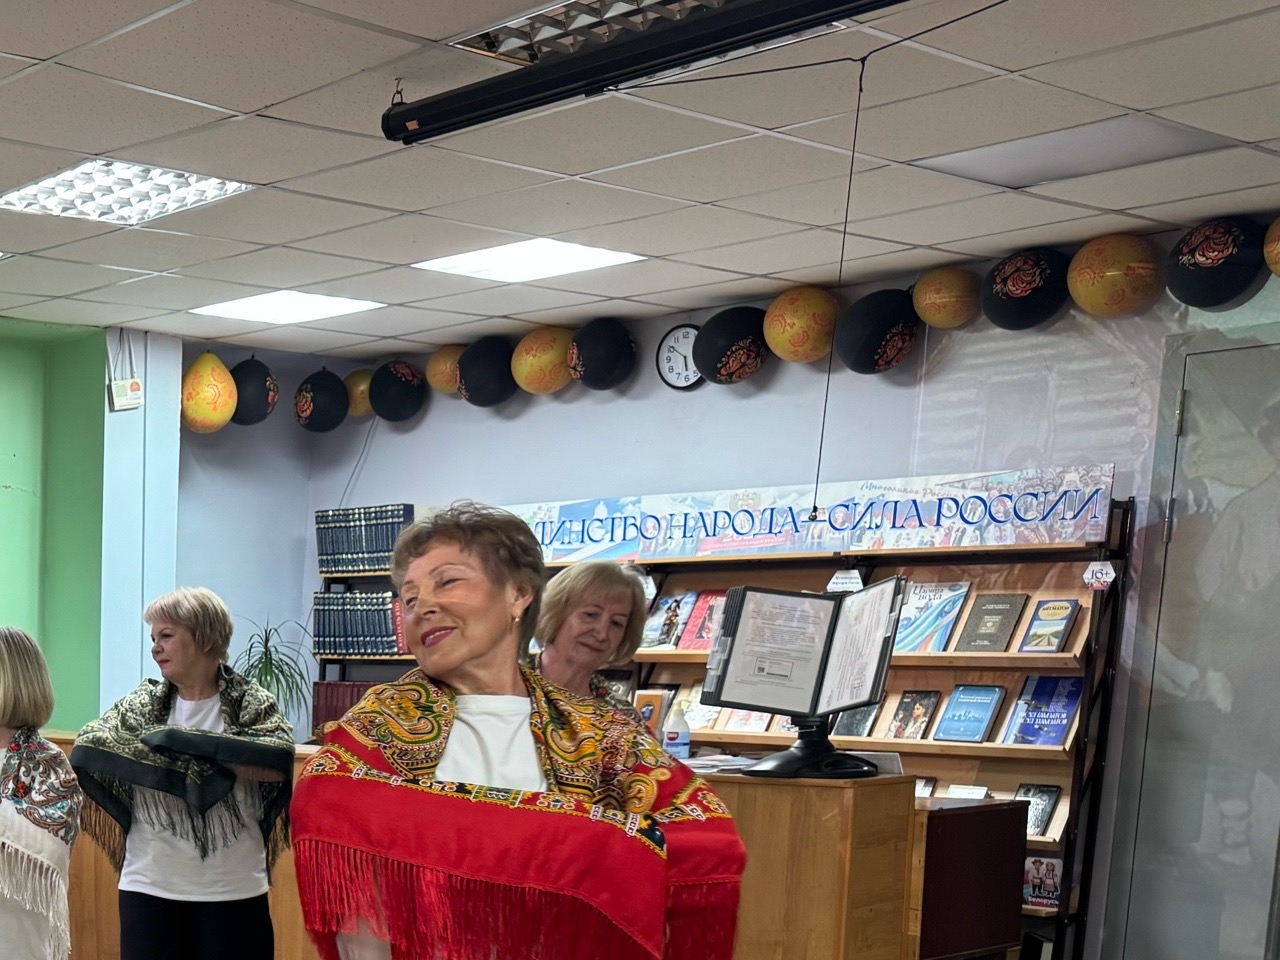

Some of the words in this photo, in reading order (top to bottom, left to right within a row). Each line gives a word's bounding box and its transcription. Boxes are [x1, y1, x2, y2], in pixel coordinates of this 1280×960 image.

[682, 331, 690, 339] 12
[665, 355, 671, 363] 9
[668, 365, 674, 373] 8
[675, 372, 681, 380] 7
[533, 514, 662, 548] ДИНСТВО
[666, 506, 801, 540] НАРОДА
[827, 498, 926, 533] СИЛА
[935, 487, 1104, 527] РОССИИ
[1091, 568, 1110, 580] 16+
